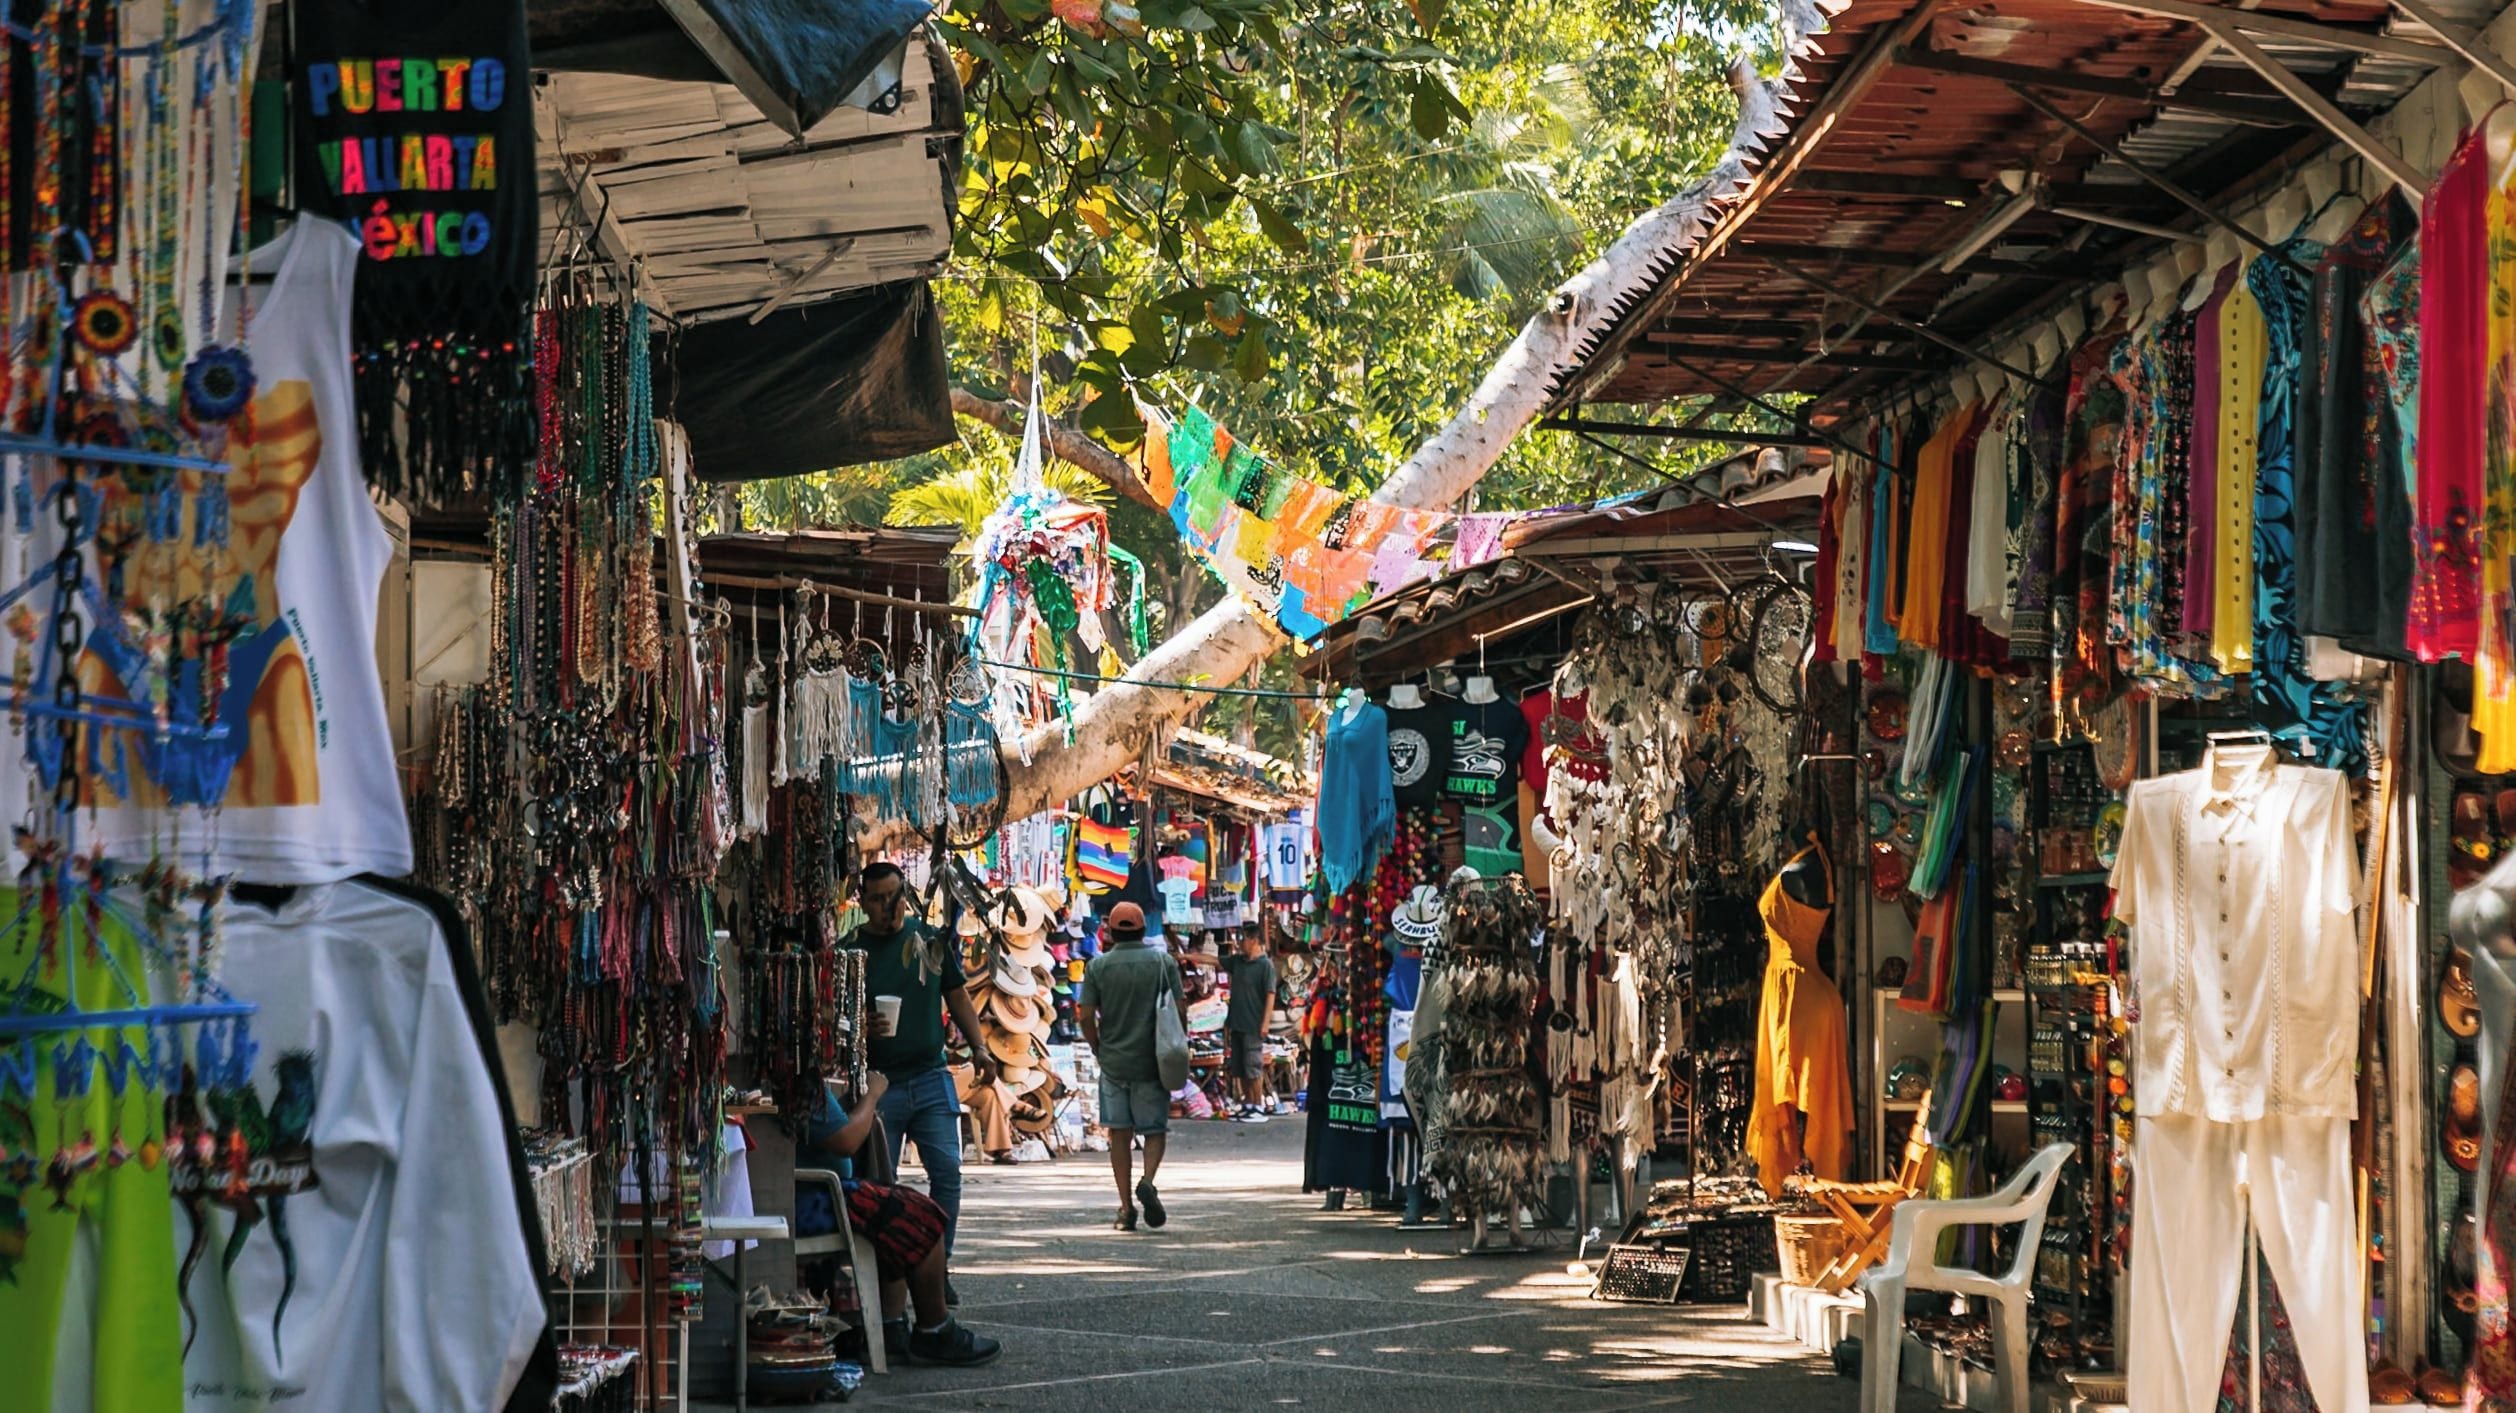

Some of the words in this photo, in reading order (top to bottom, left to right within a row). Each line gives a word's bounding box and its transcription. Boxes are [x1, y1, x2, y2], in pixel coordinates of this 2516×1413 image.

[308, 57, 506, 117] PUERTO
[318, 132, 497, 197] VALLARTA
[350, 199, 490, 261] éXICO
[1447, 776, 1496, 795] HAWKS
[1278, 843, 1296, 865] 10
[1203, 896, 1238, 913] TRUMP
[1329, 1103, 1377, 1124] HAWKS
